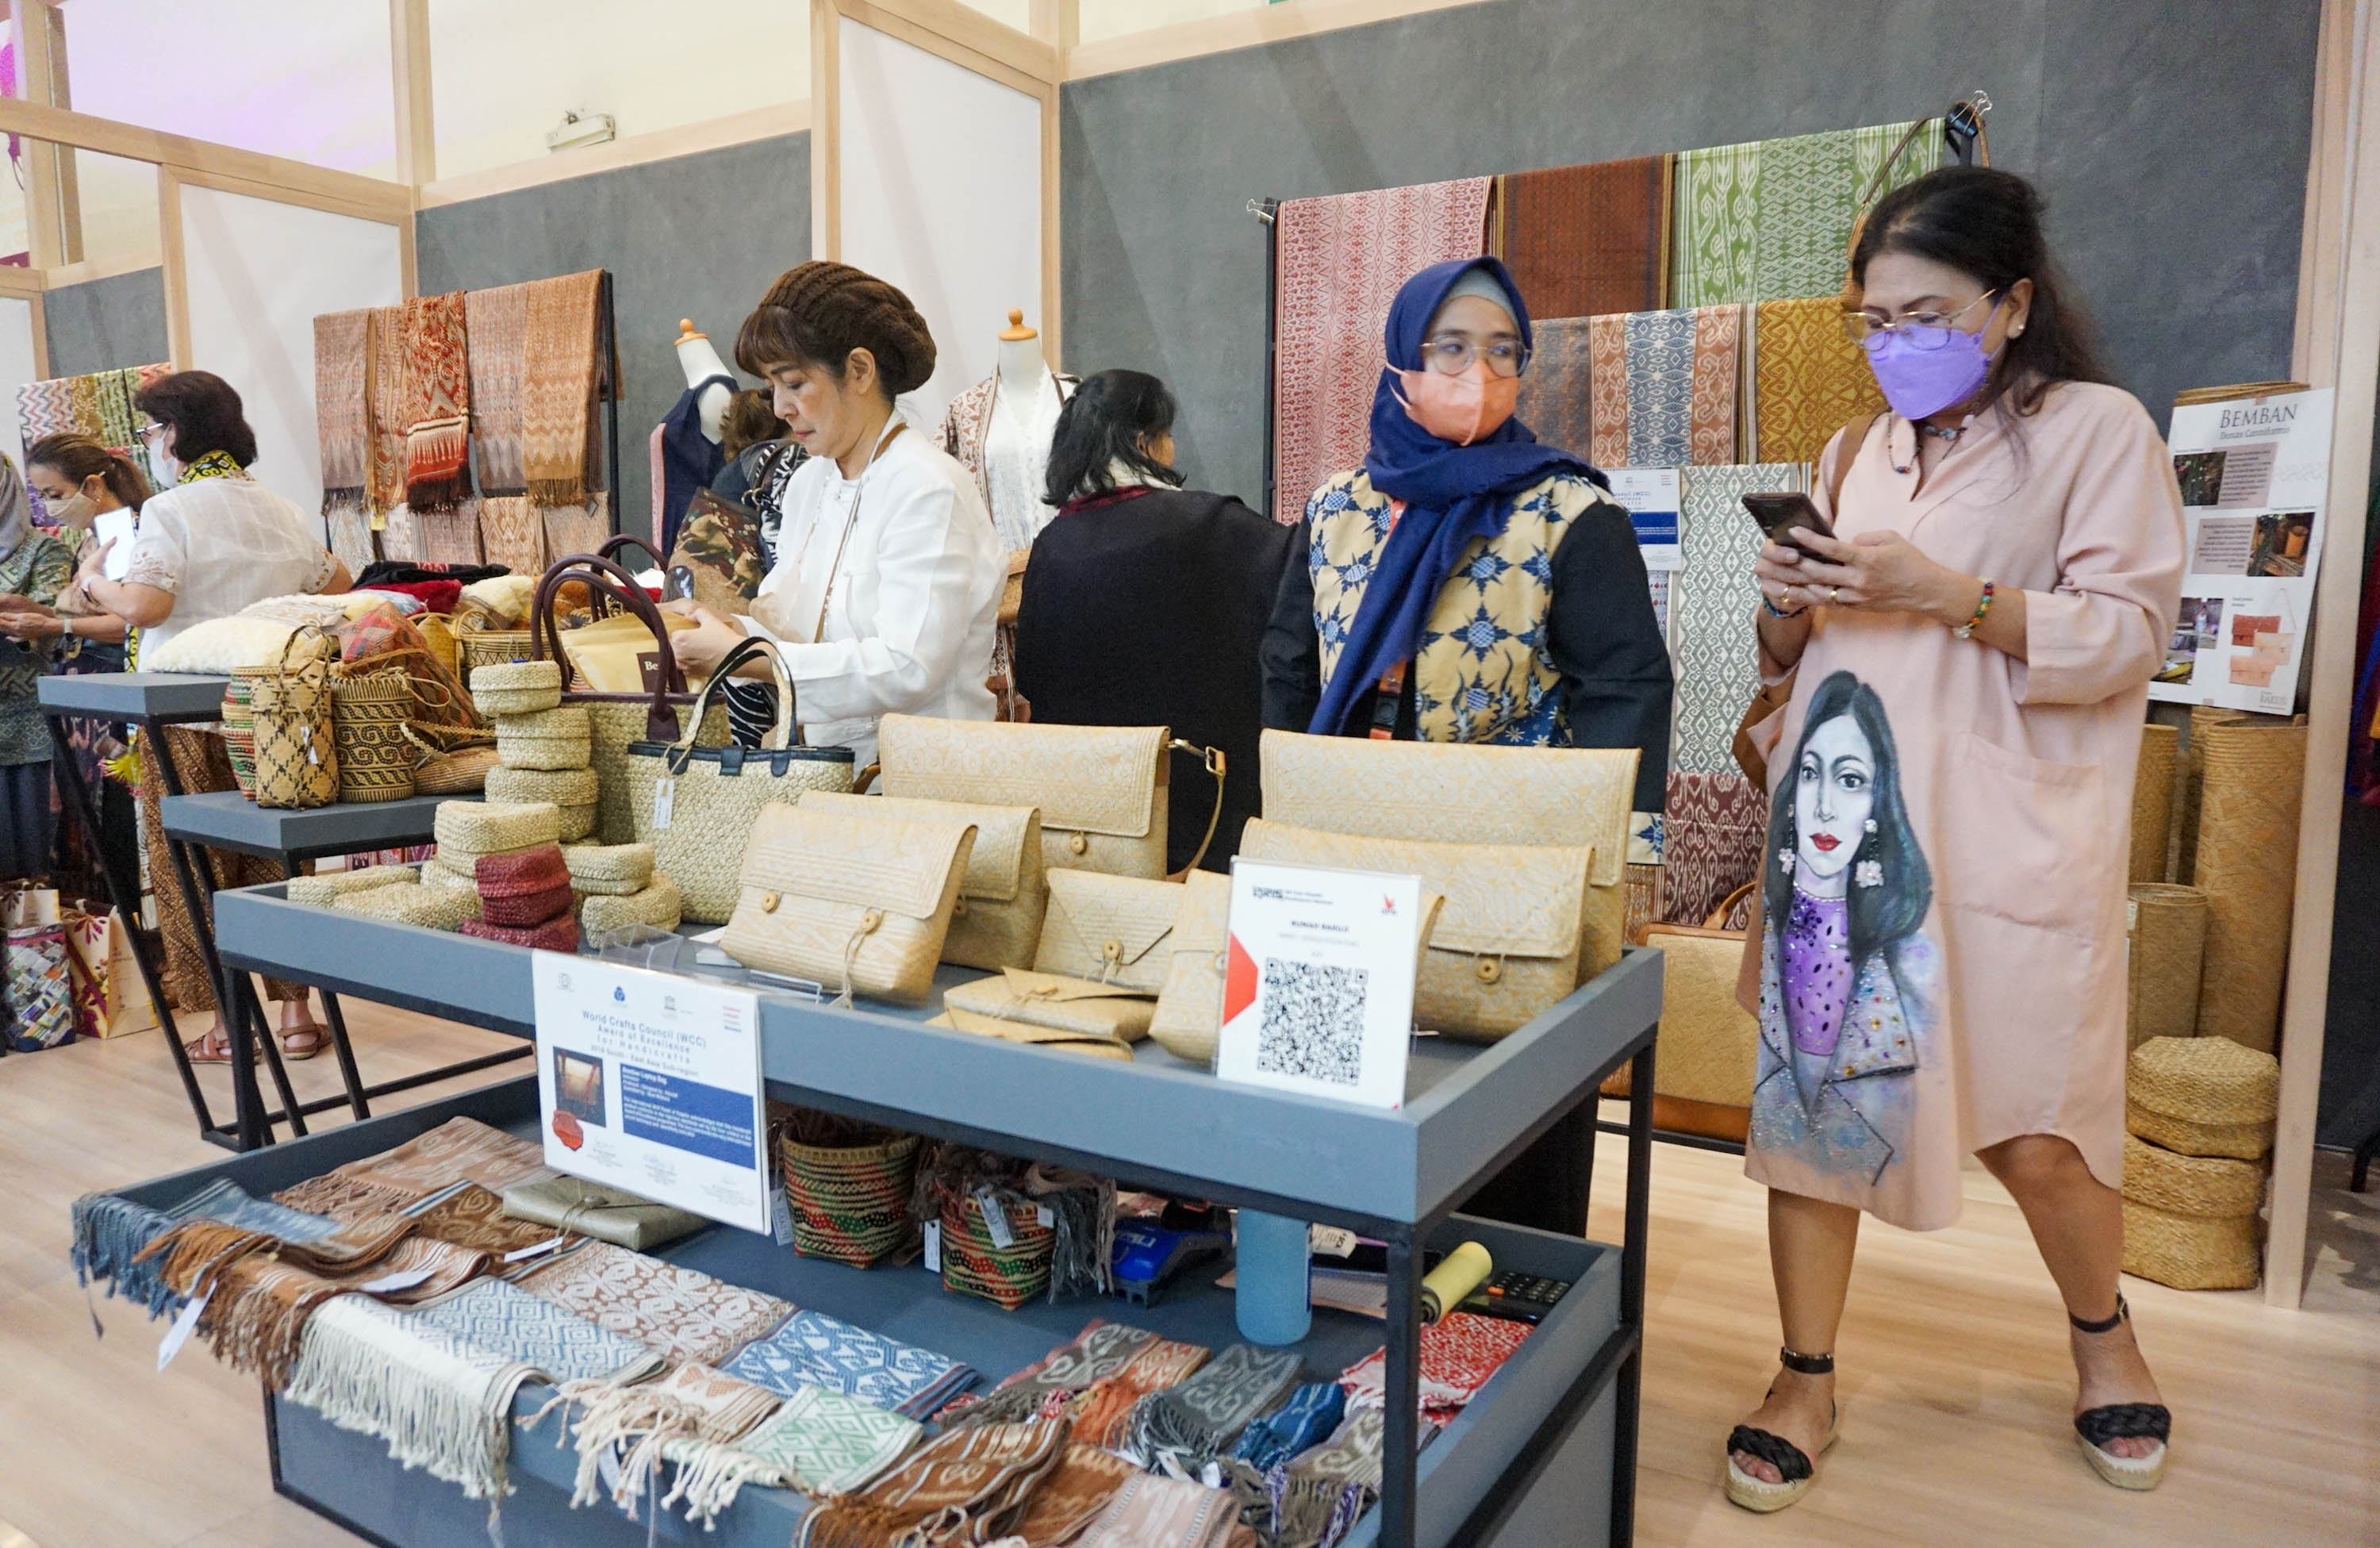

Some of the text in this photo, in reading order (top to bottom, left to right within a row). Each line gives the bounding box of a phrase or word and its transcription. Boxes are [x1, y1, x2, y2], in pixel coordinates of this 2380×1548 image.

[582, 1009, 707, 1048] World Crafts Council (WCC)
[597, 1024, 624, 1038] Award
[640, 1035, 690, 1054] Excellence
[620, 1039, 690, 1064] Handicrafts
